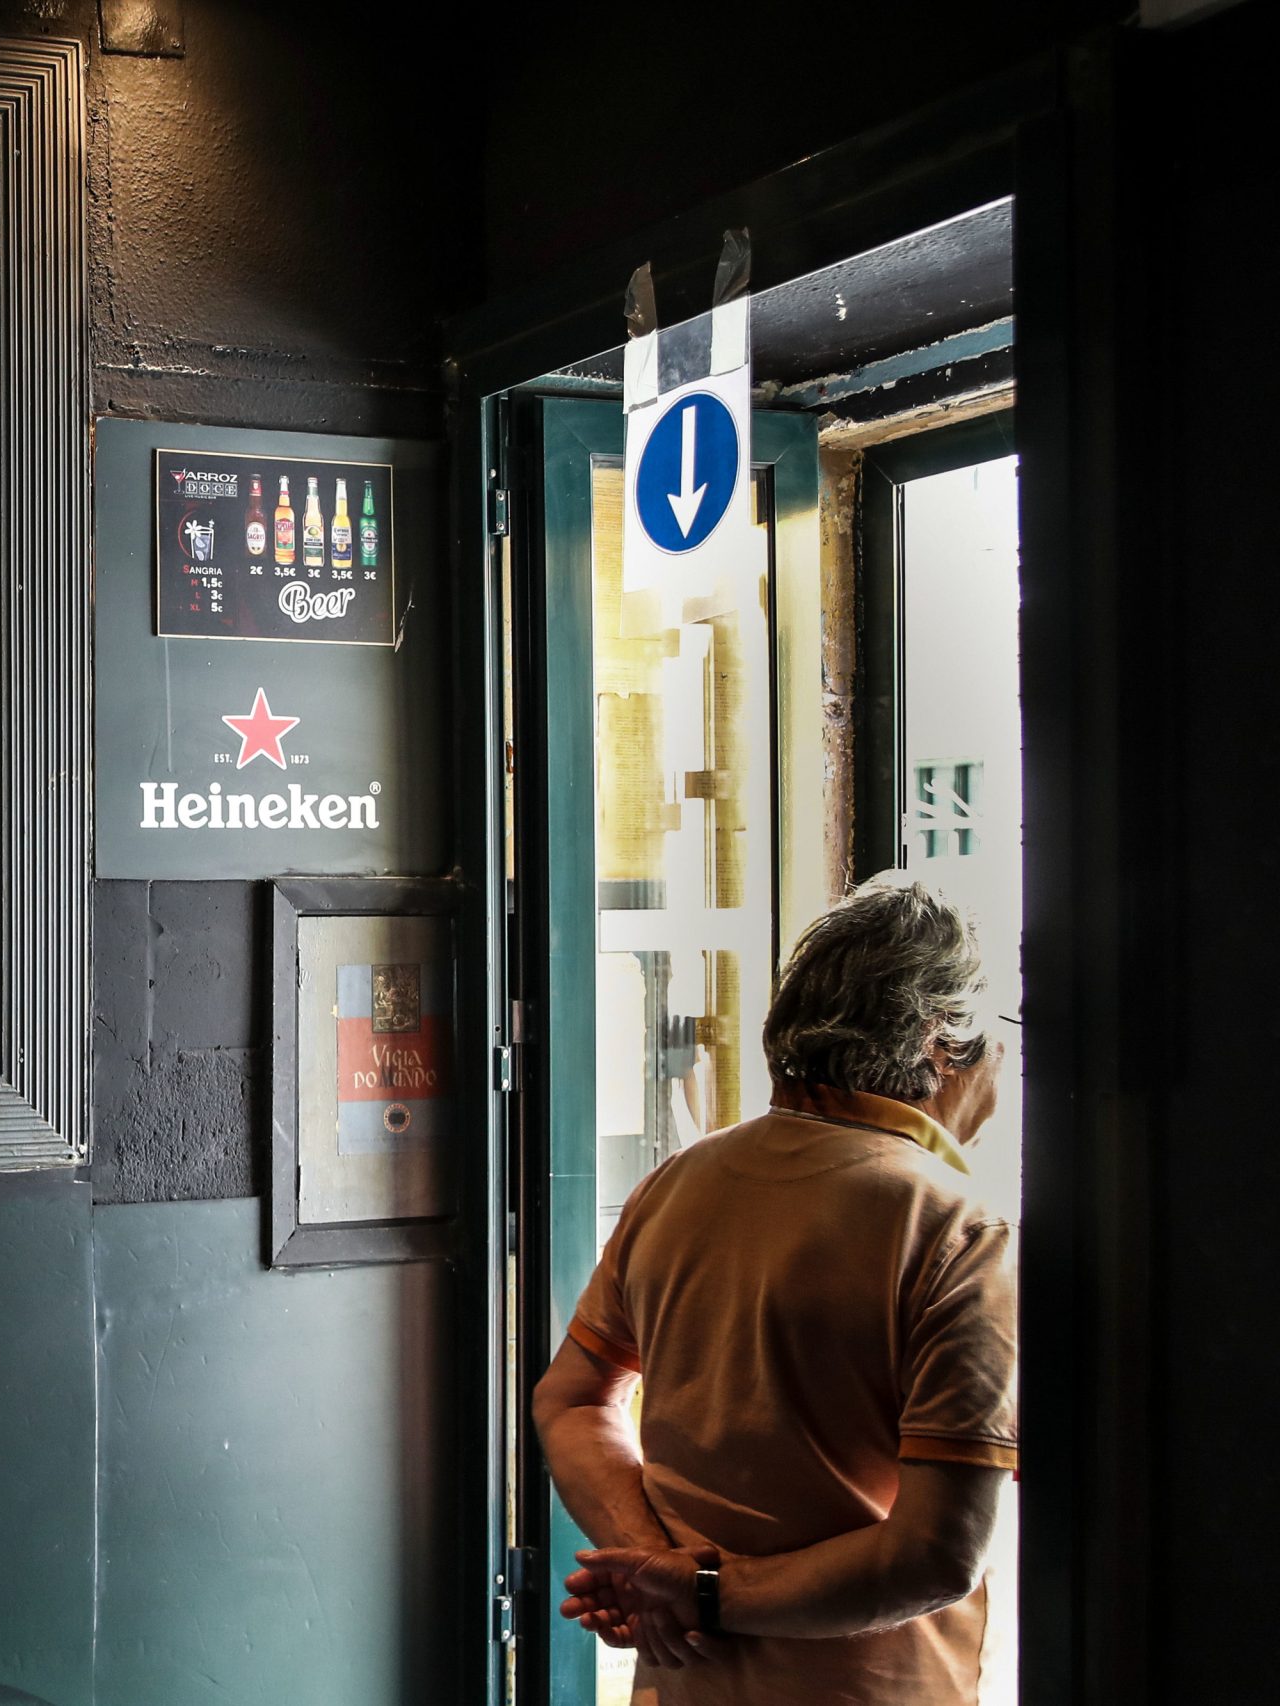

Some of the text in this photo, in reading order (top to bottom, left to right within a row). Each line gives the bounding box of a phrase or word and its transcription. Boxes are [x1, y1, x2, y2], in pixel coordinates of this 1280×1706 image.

[185, 471, 238, 483] ARROZ
[186, 482, 237, 496] DOCE
[183, 564, 223, 575] SANGRIA
[250, 565, 263, 575] 2€
[274, 567, 296, 578] 3,5€
[308, 568, 320, 578] 3€
[332, 569, 353, 580] 3,5€
[364, 571, 377, 580] 3€
[278, 580, 356, 623] Beer
[214, 754, 309, 764] EST. 1873
